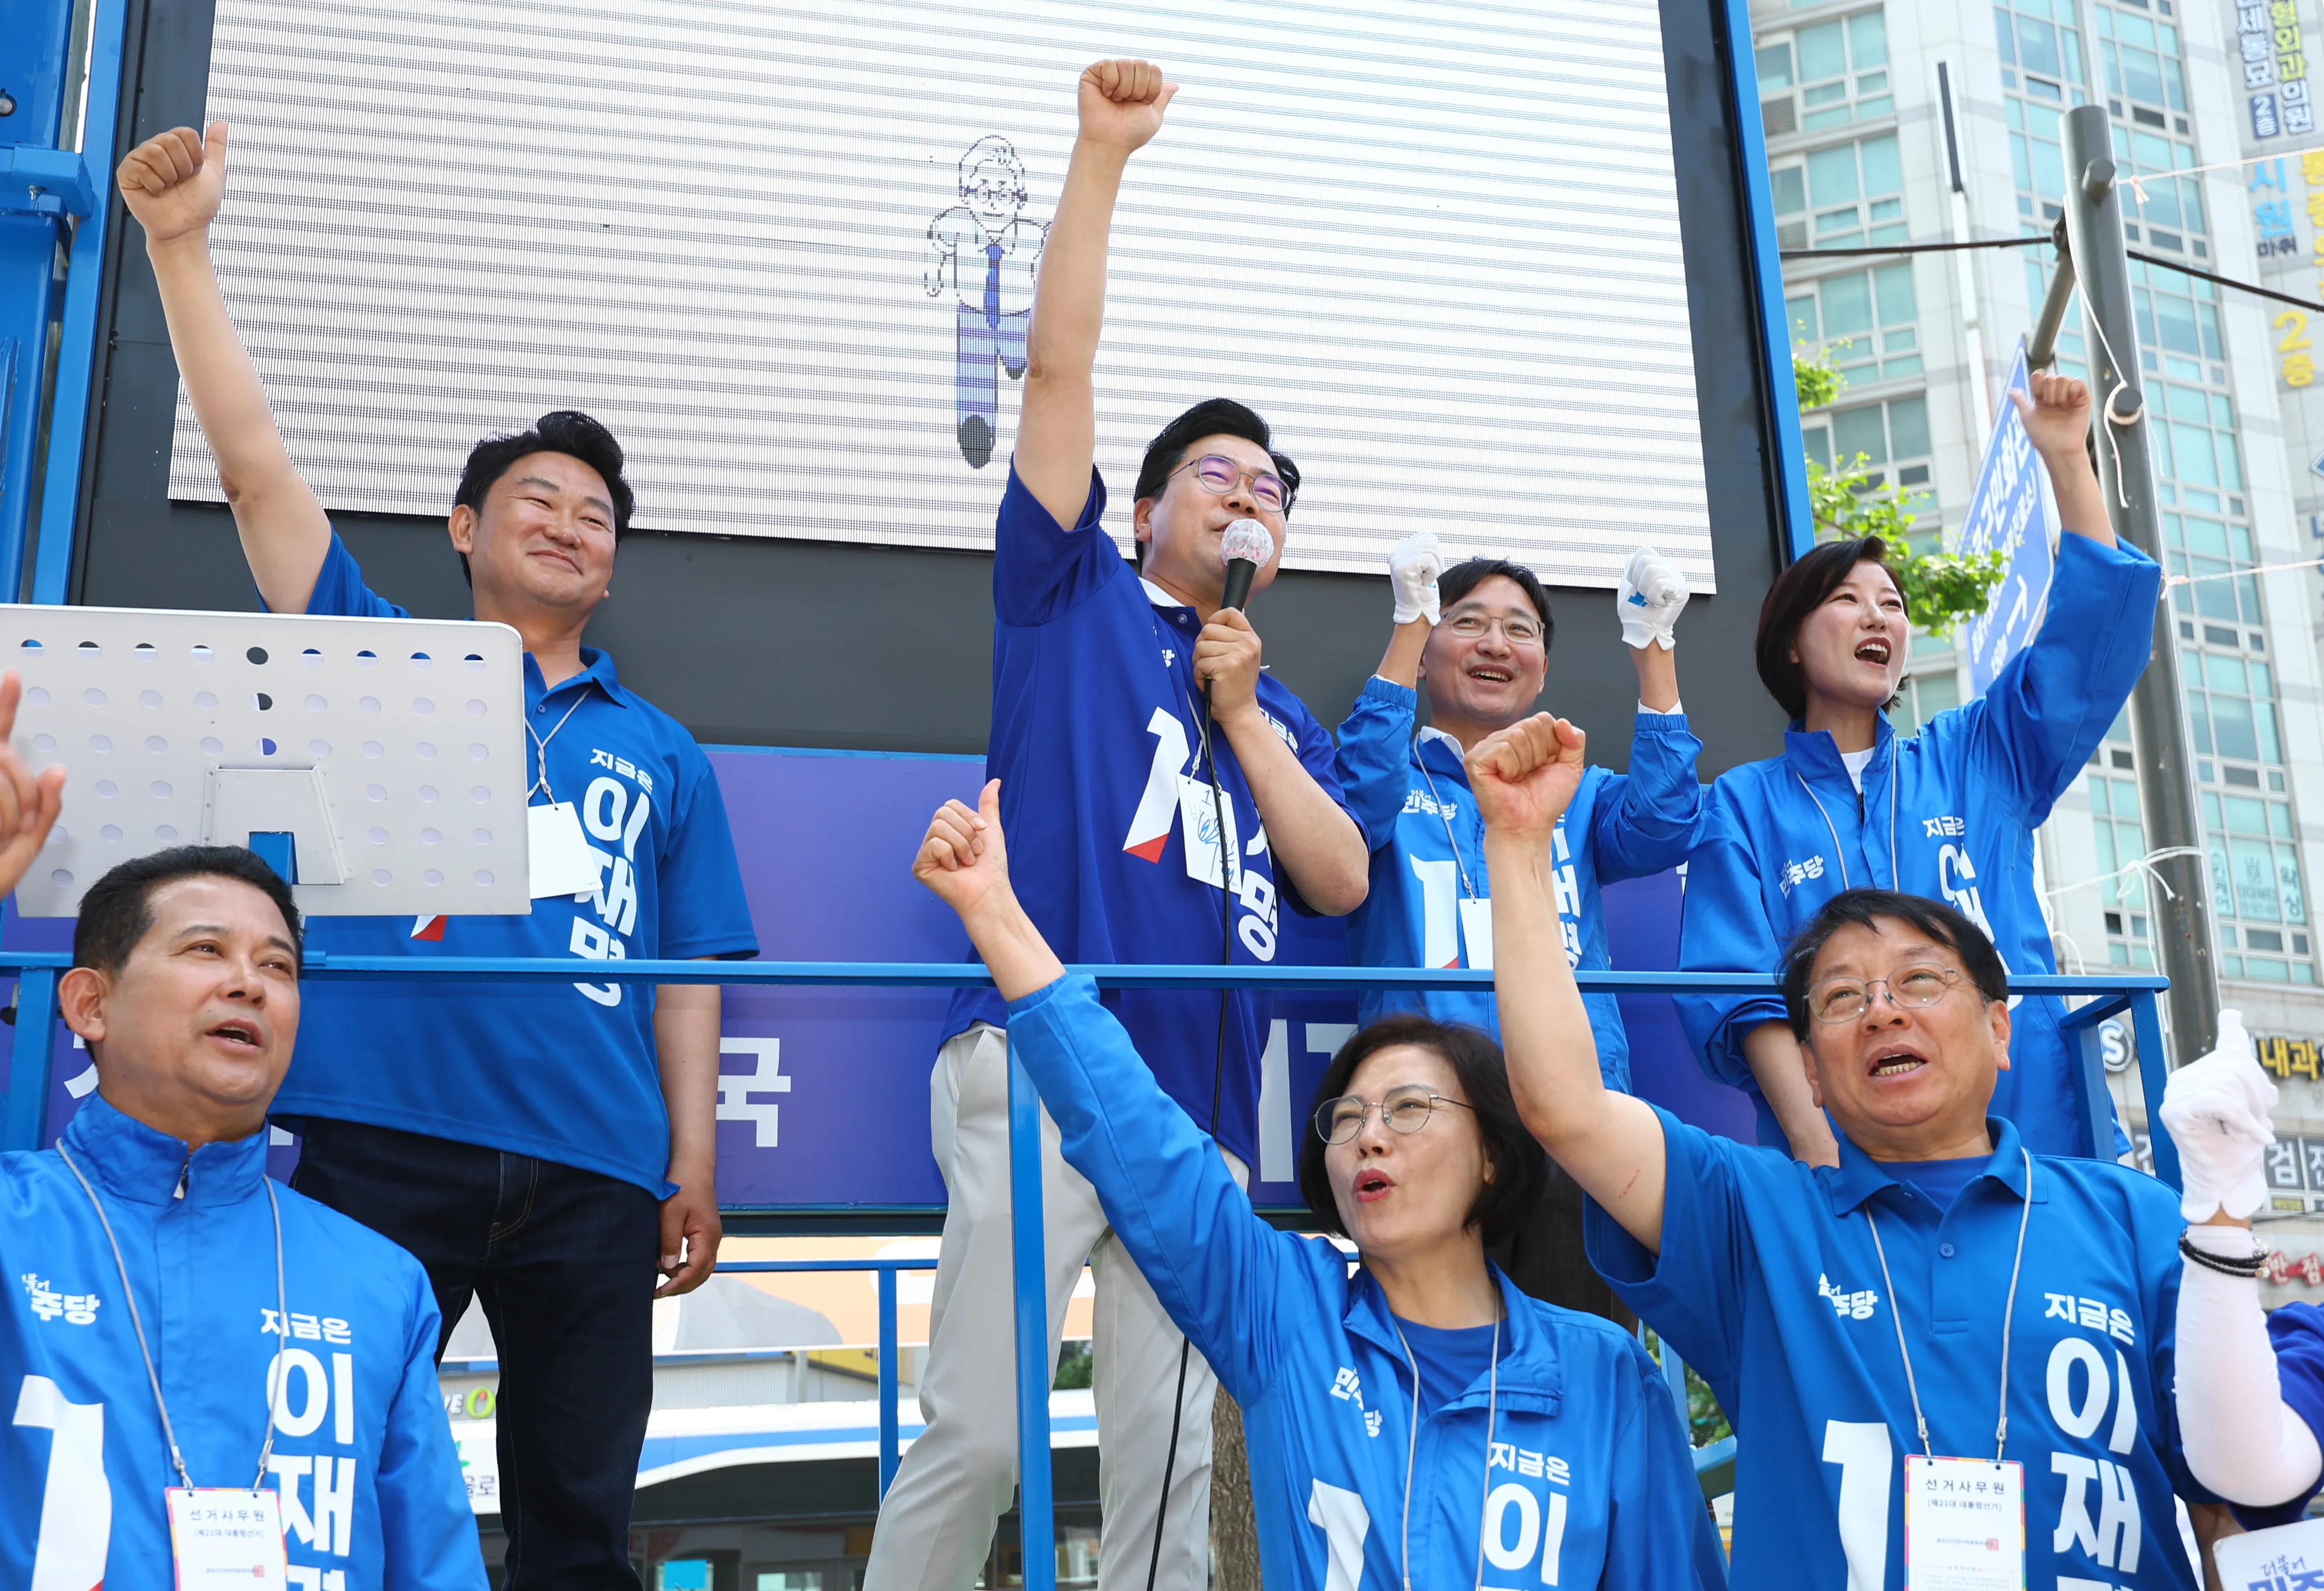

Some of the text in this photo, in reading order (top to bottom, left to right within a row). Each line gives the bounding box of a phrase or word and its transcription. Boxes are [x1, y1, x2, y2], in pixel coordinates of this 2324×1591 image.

[2273, 310, 2316, 388] 2층
[590, 748, 654, 795] 지금은
[1122, 706, 1190, 864] 1
[1401, 795, 1458, 821] 민주당
[1922, 815, 1965, 838] 지금은
[1409, 852, 1459, 969] 1
[29, 1288, 101, 1325] 주당
[260, 1308, 352, 1344] 지금은
[2044, 1292, 2135, 1346] 지금은
[13, 1374, 112, 1591] 1
[1489, 1441, 1570, 1486] 지금은
[2046, 1337, 2142, 1591] 이재
[1822, 1419, 1893, 1591] 1
[1925, 1478, 2005, 1495] 선거사무원
[1927, 1498, 2002, 1511] (제21대 대통령선거)
[190, 1509, 266, 1522] 선거사무원
[2260, 1554, 2307, 1577] 더불어
